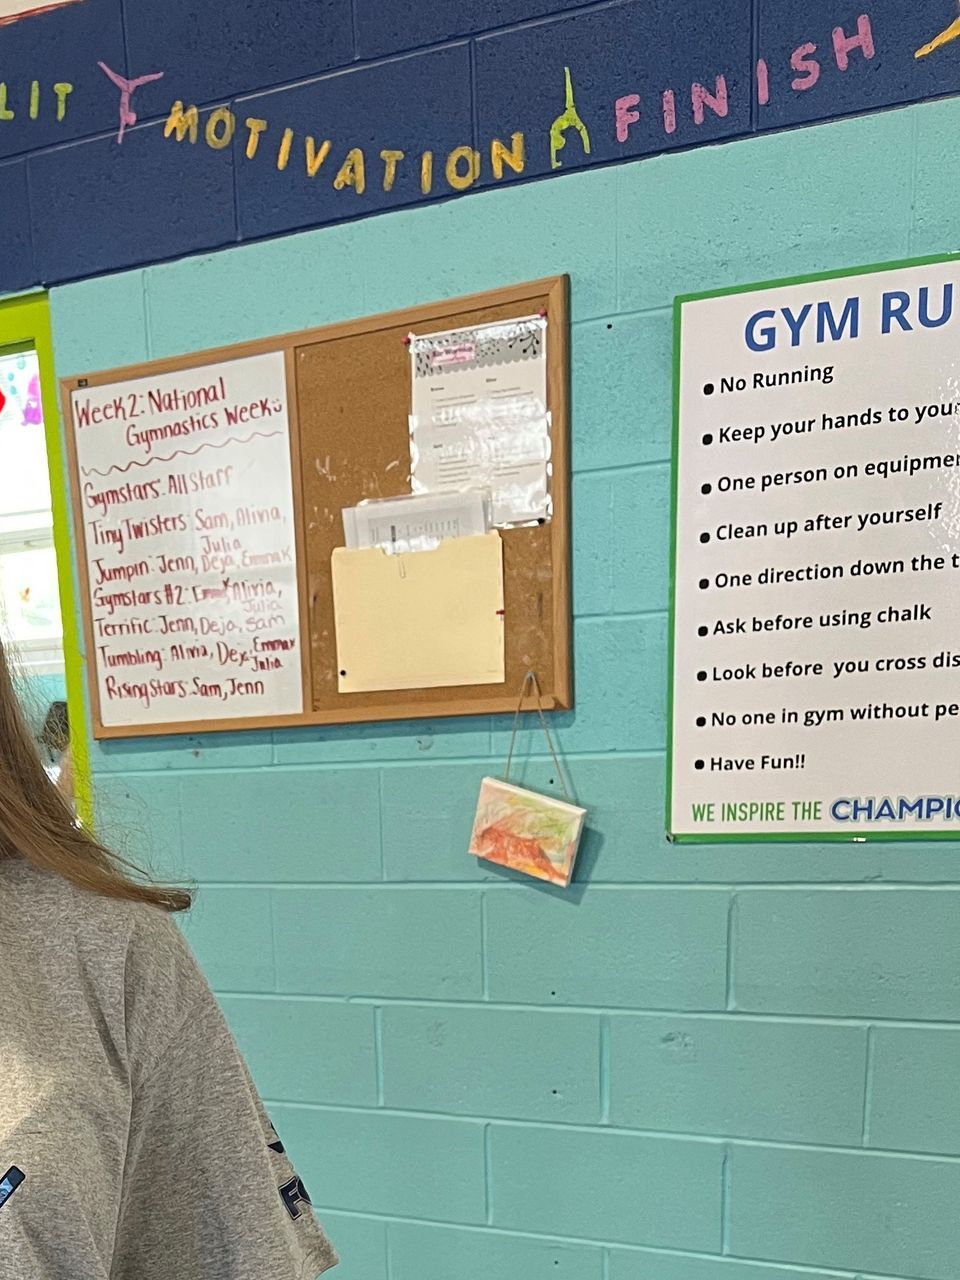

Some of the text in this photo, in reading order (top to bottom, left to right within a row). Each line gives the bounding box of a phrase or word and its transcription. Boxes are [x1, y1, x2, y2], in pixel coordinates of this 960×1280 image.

[164, 100, 525, 195] MOTIVATION
[615, 14, 876, 143] FINISH
[744, 283, 954, 353] GYM RU
[720, 365, 835, 394] No Running
[148, 377, 227, 417] National
[126, 398, 273, 454] Gymnastics Week
[718, 425, 766, 445] Keep
[770, 417, 816, 442] your
[821, 408, 882, 431] hands
[888, 406, 909, 423] to
[168, 474, 189, 496] All
[190, 465, 234, 492] Staff
[717, 475, 756, 493] One
[760, 467, 827, 492] person
[833, 464, 859, 480] on
[88, 519, 124, 554] Tiny
[194, 508, 235, 531] Sam,
[715, 502, 943, 541] Clean up after yourself
[200, 535, 242, 555] Julia
[156, 554, 199, 575] Jenn,
[714, 572, 752, 589] One
[757, 564, 844, 585] direction
[849, 559, 905, 577] down
[911, 554, 945, 572] the
[93, 586, 162, 615] Gymstars
[158, 614, 198, 636] Jenn,
[712, 603, 932, 636] Ask before using chalk
[712, 664, 757, 682] Look
[761, 661, 824, 679] before
[832, 659, 869, 679] you
[874, 655, 927, 672] cross
[105, 675, 151, 710] Rising
[226, 678, 265, 697] Jenn
[711, 712, 737, 728] No
[741, 710, 776, 726] one
[781, 708, 798, 724] in
[803, 708, 844, 727] gym
[850, 702, 930, 721] without
[709, 753, 806, 772] Have Fun!!
[692, 802, 715, 822] WE
[721, 801, 786, 822] INSPIRE
[791, 800, 823, 821] THE
